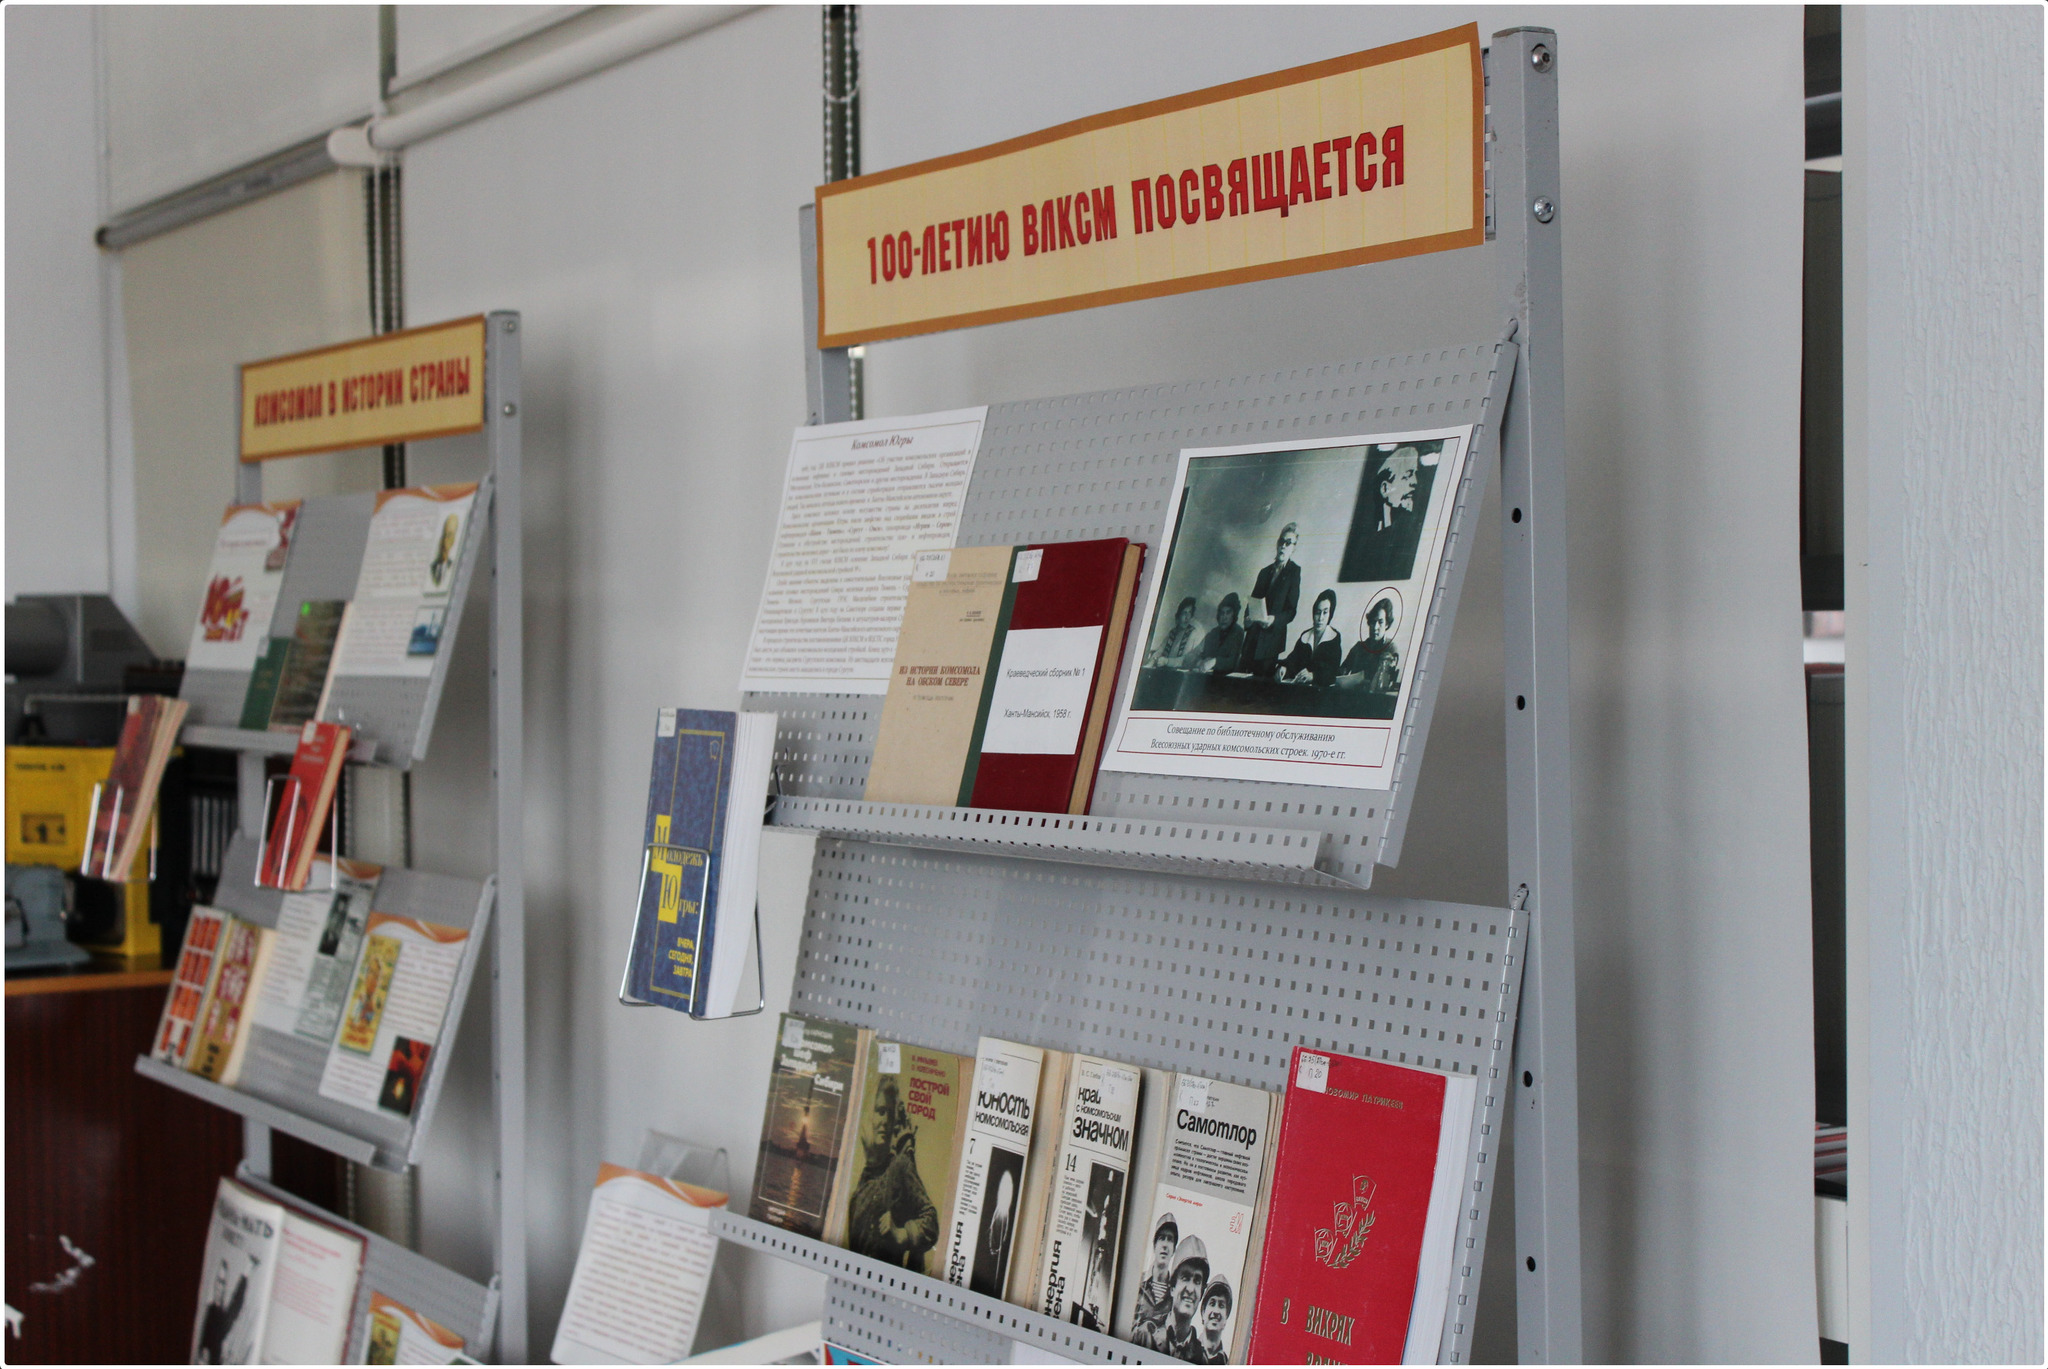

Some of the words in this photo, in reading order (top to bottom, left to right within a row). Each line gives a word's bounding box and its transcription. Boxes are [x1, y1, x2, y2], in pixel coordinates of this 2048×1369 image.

[867, 210, 1009, 284] 100-ЛЕТИЮ
[1023, 185, 1117, 257] ВЛКСМ
[1131, 124, 1404, 234] ПОСВЯЩАЕТСЯ
[329, 381, 337, 417] В
[342, 368, 404, 414] ИСТОРИИ
[410, 355, 470, 403] СТРАНЫ
[910, 666, 938, 675] ИСТОРИИ
[940, 666, 980, 675] КОМСОМОЛА
[1006, 668, 1049, 679] Краеведческий
[1049, 668, 1073, 678] сборник
[906, 677, 916, 686] НА
[945, 677, 969, 687] СЕВЕРЕ
[1053, 708, 1068, 719] 1958
[1167, 724, 1206, 736] Совещание
[1206, 727, 1216, 736] по
[1216, 726, 1275, 742] библиотечному
[1276, 729, 1335, 742] обслуживанию
[1151, 739, 1190, 750] Всесоюзных
[1190, 741, 1221, 753] ударных
[1222, 744, 1279, 755] комсомольских
[1280, 747, 1308, 758] строек.
[1311, 750, 1335, 760] 1970-е
[910, 1077, 950, 1096] ПОСТРОЙ
[908, 1090, 932, 1105] СВОЙ
[907, 1102, 936, 1121] ГОРОД
[1177, 1109, 1257, 1150] Самотлор
[969, 1138, 976, 1155] 7
[1065, 1153, 1077, 1172] 14
[1280, 1297, 1290, 1324] В
[1305, 1305, 1355, 1346] ВИХРЯХ
